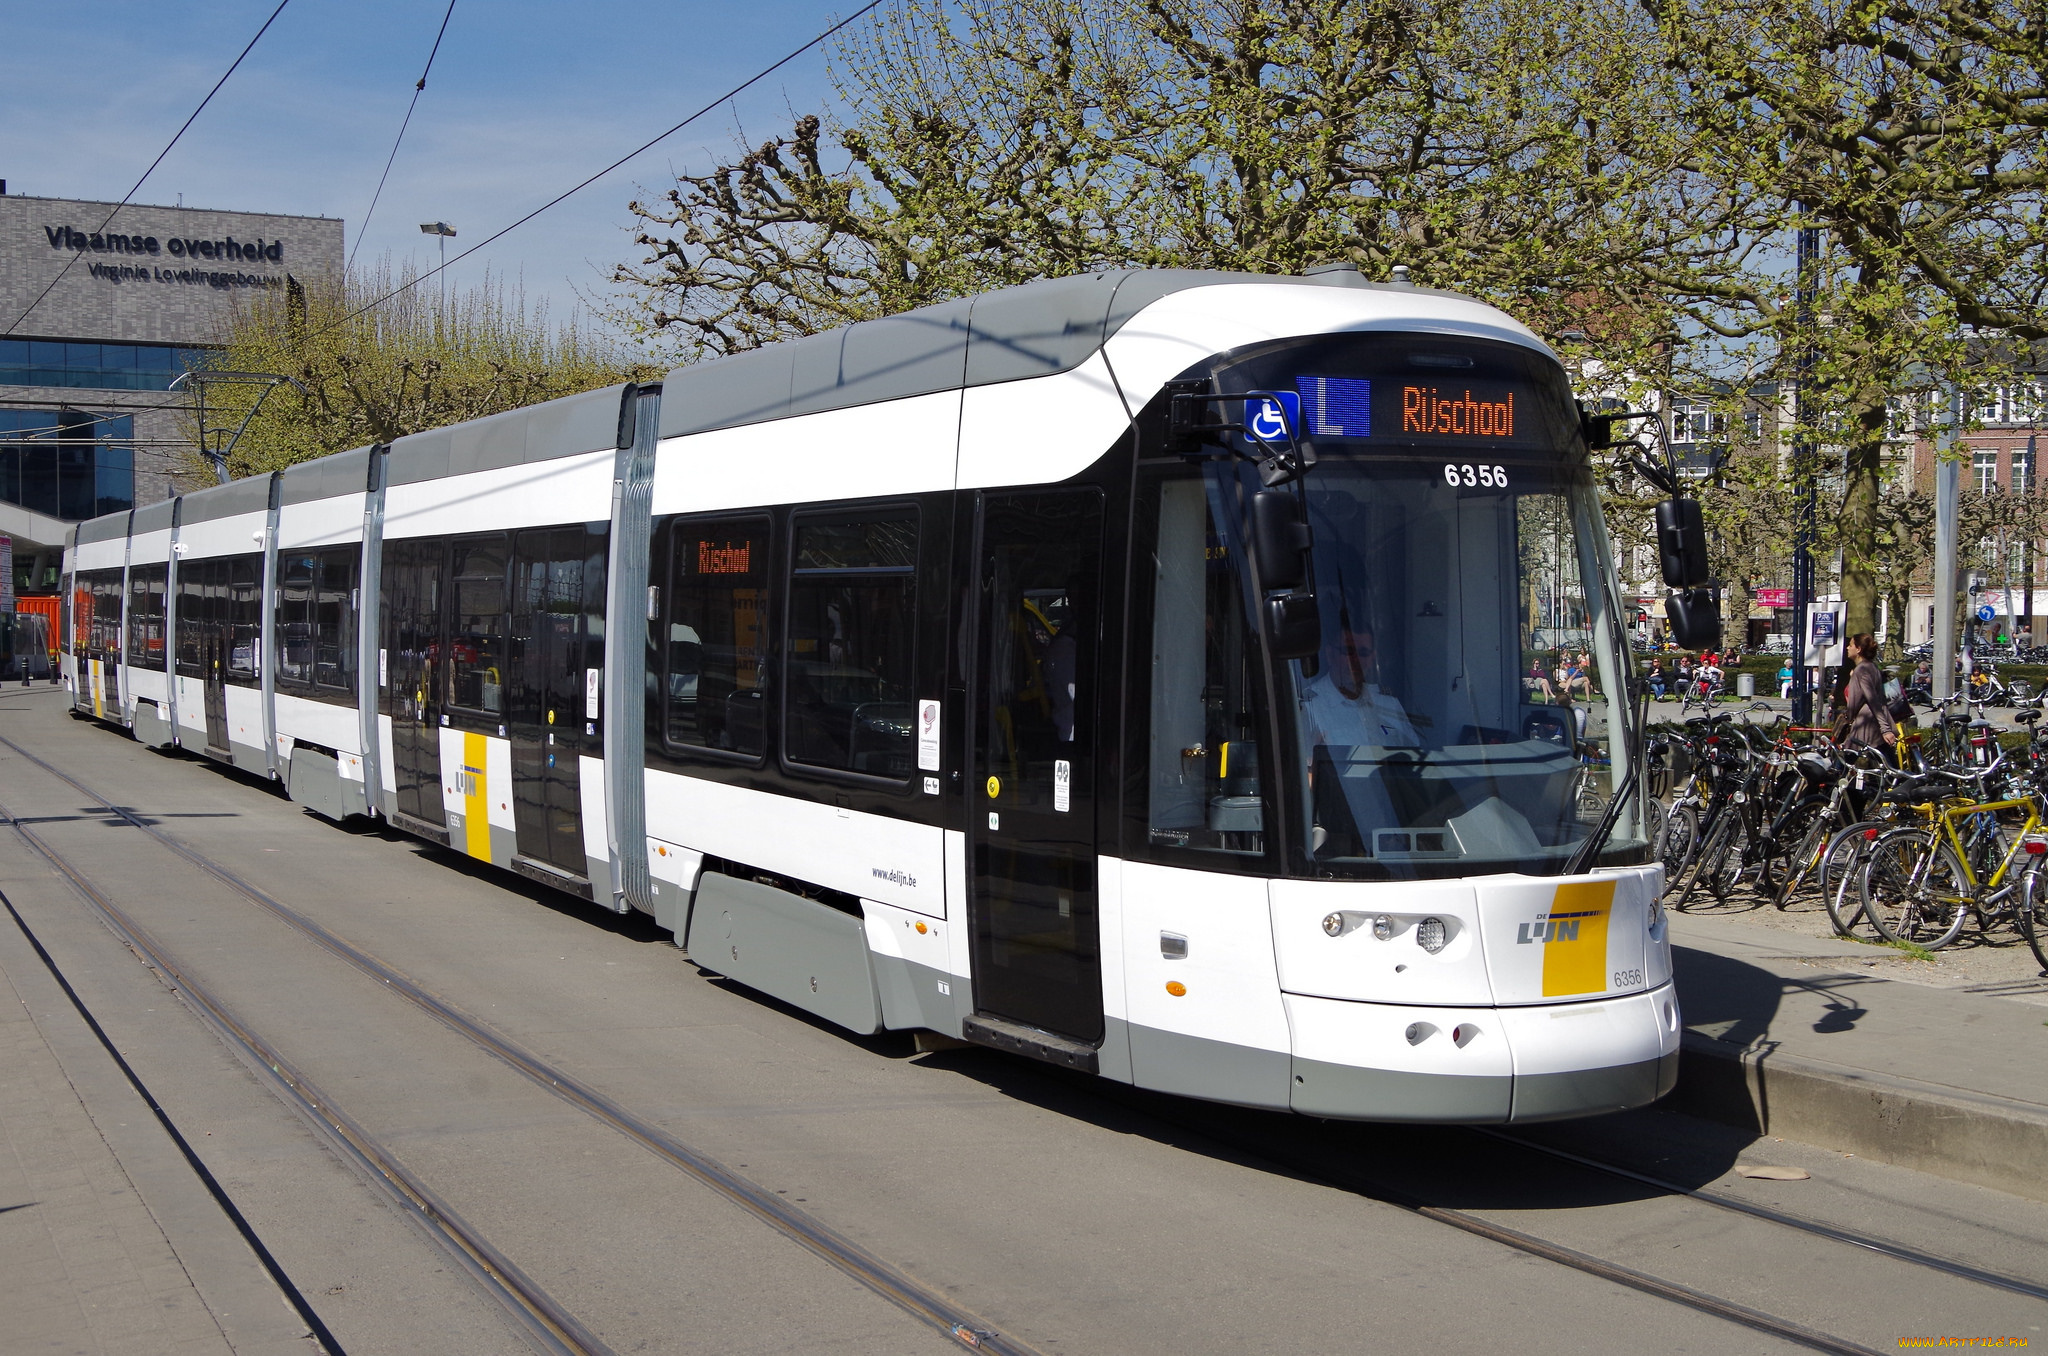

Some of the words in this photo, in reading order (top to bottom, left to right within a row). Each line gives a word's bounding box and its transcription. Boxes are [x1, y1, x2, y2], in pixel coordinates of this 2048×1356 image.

[45, 226, 158, 253] Vlaamse
[167, 236, 283, 261] overheid
[88, 262, 149, 282] Virginie
[155, 265, 281, 287] Lovelinggebouw
[1317, 377, 1344, 436] L
[1403, 386, 1513, 435] Rijschool
[1444, 464, 1508, 488] 6356
[872, 868, 916, 887] www.delijn.be
[1517, 920, 1580, 944] LIJN
[1614, 969, 1642, 988] 6356
